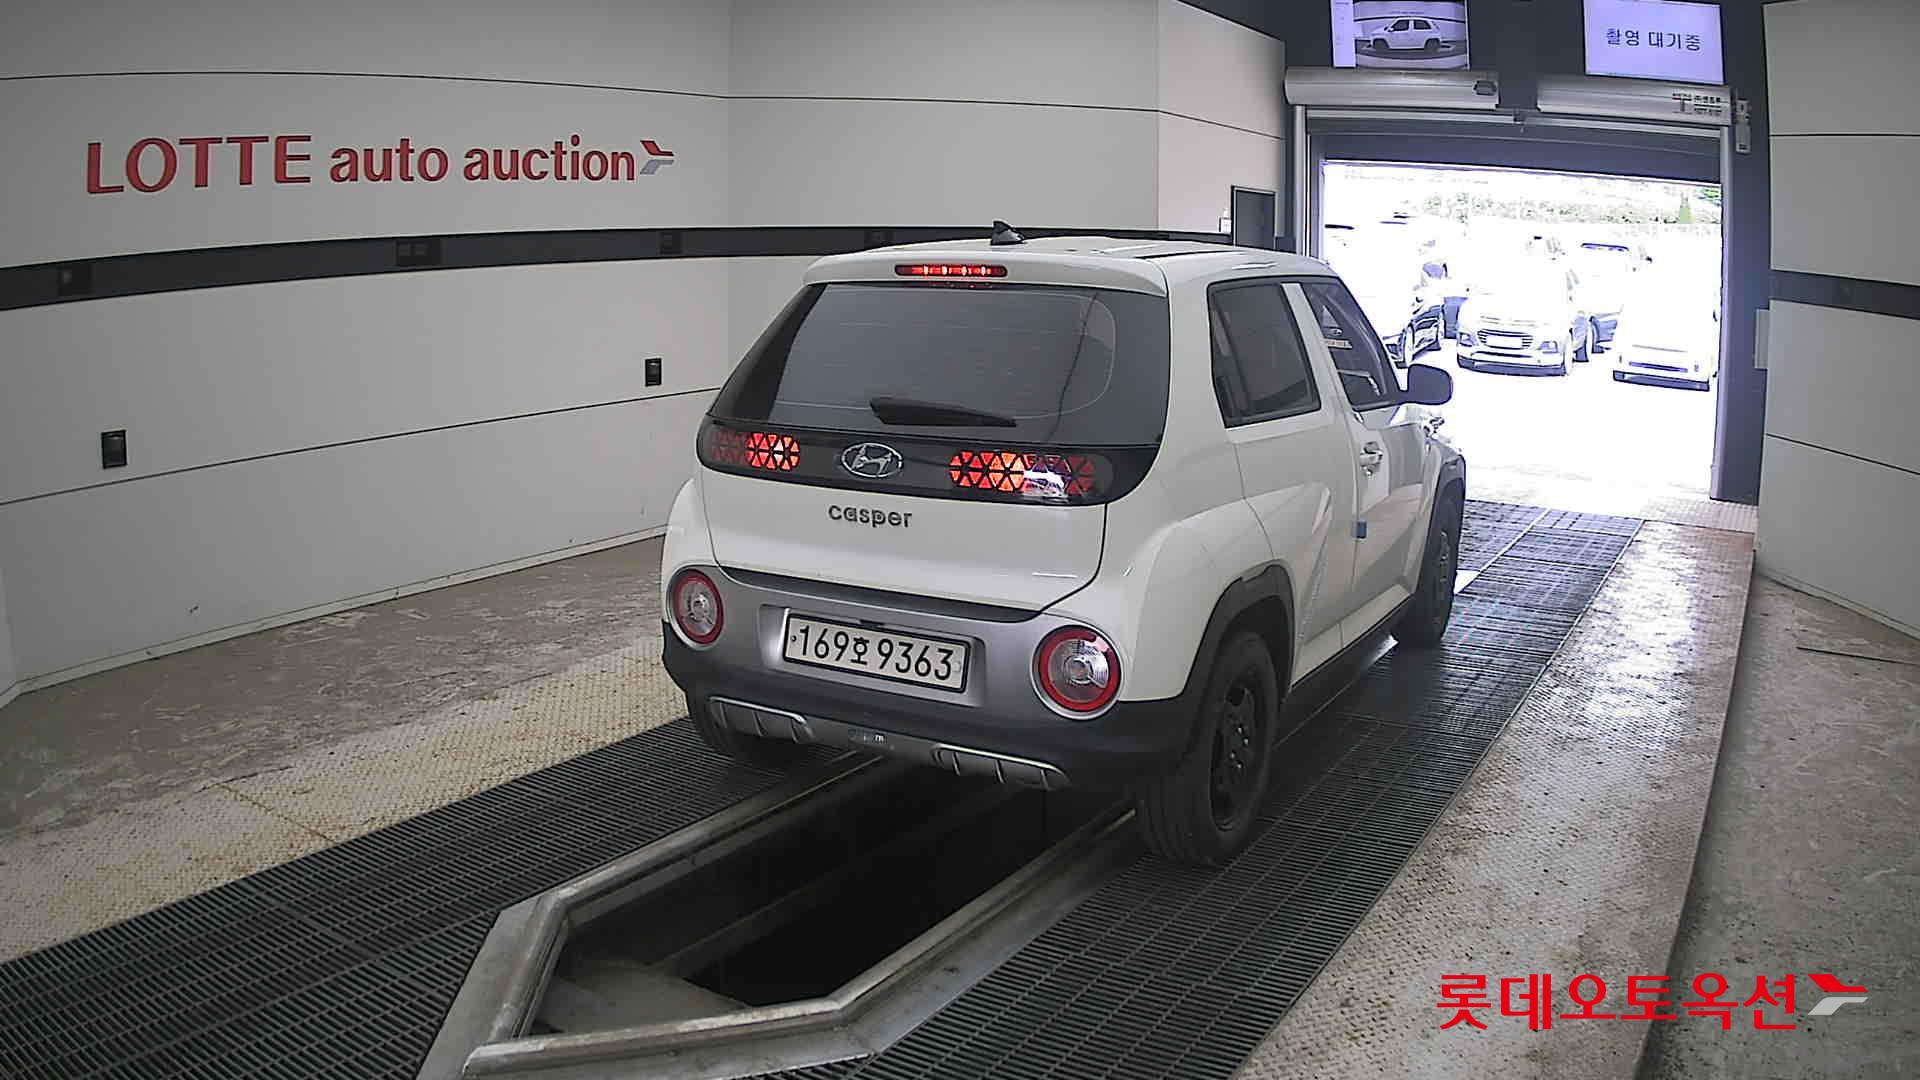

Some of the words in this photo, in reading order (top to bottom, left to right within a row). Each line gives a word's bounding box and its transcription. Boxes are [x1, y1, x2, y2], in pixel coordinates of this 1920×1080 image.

[1606, 27, 1640, 47] 촬영
[1648, 31, 1701, 52] 대기중
[86, 135, 312, 195] LOTTE
[330, 138, 449, 183] auto
[463, 134, 636, 183] auction
[828, 503, 913, 529] casper
